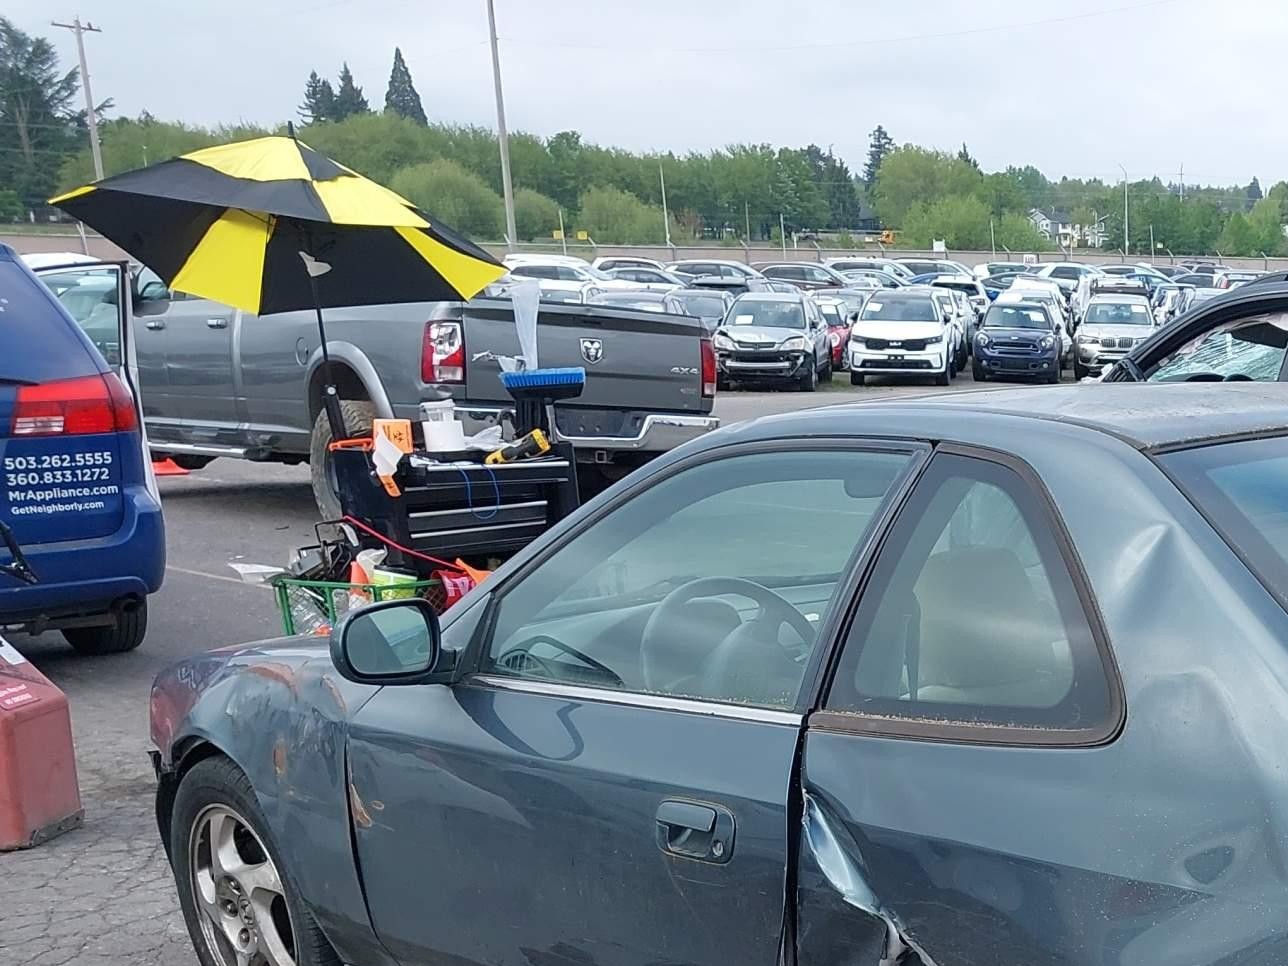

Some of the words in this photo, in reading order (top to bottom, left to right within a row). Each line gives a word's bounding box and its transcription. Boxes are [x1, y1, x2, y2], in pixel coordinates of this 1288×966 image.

[4, 452, 113, 470] 503.262.5555
[6, 468, 110, 486] 360.833.1272
[8, 485, 119, 501] MrAppliance.com
[11, 501, 105, 515] GetNeighborly.com
